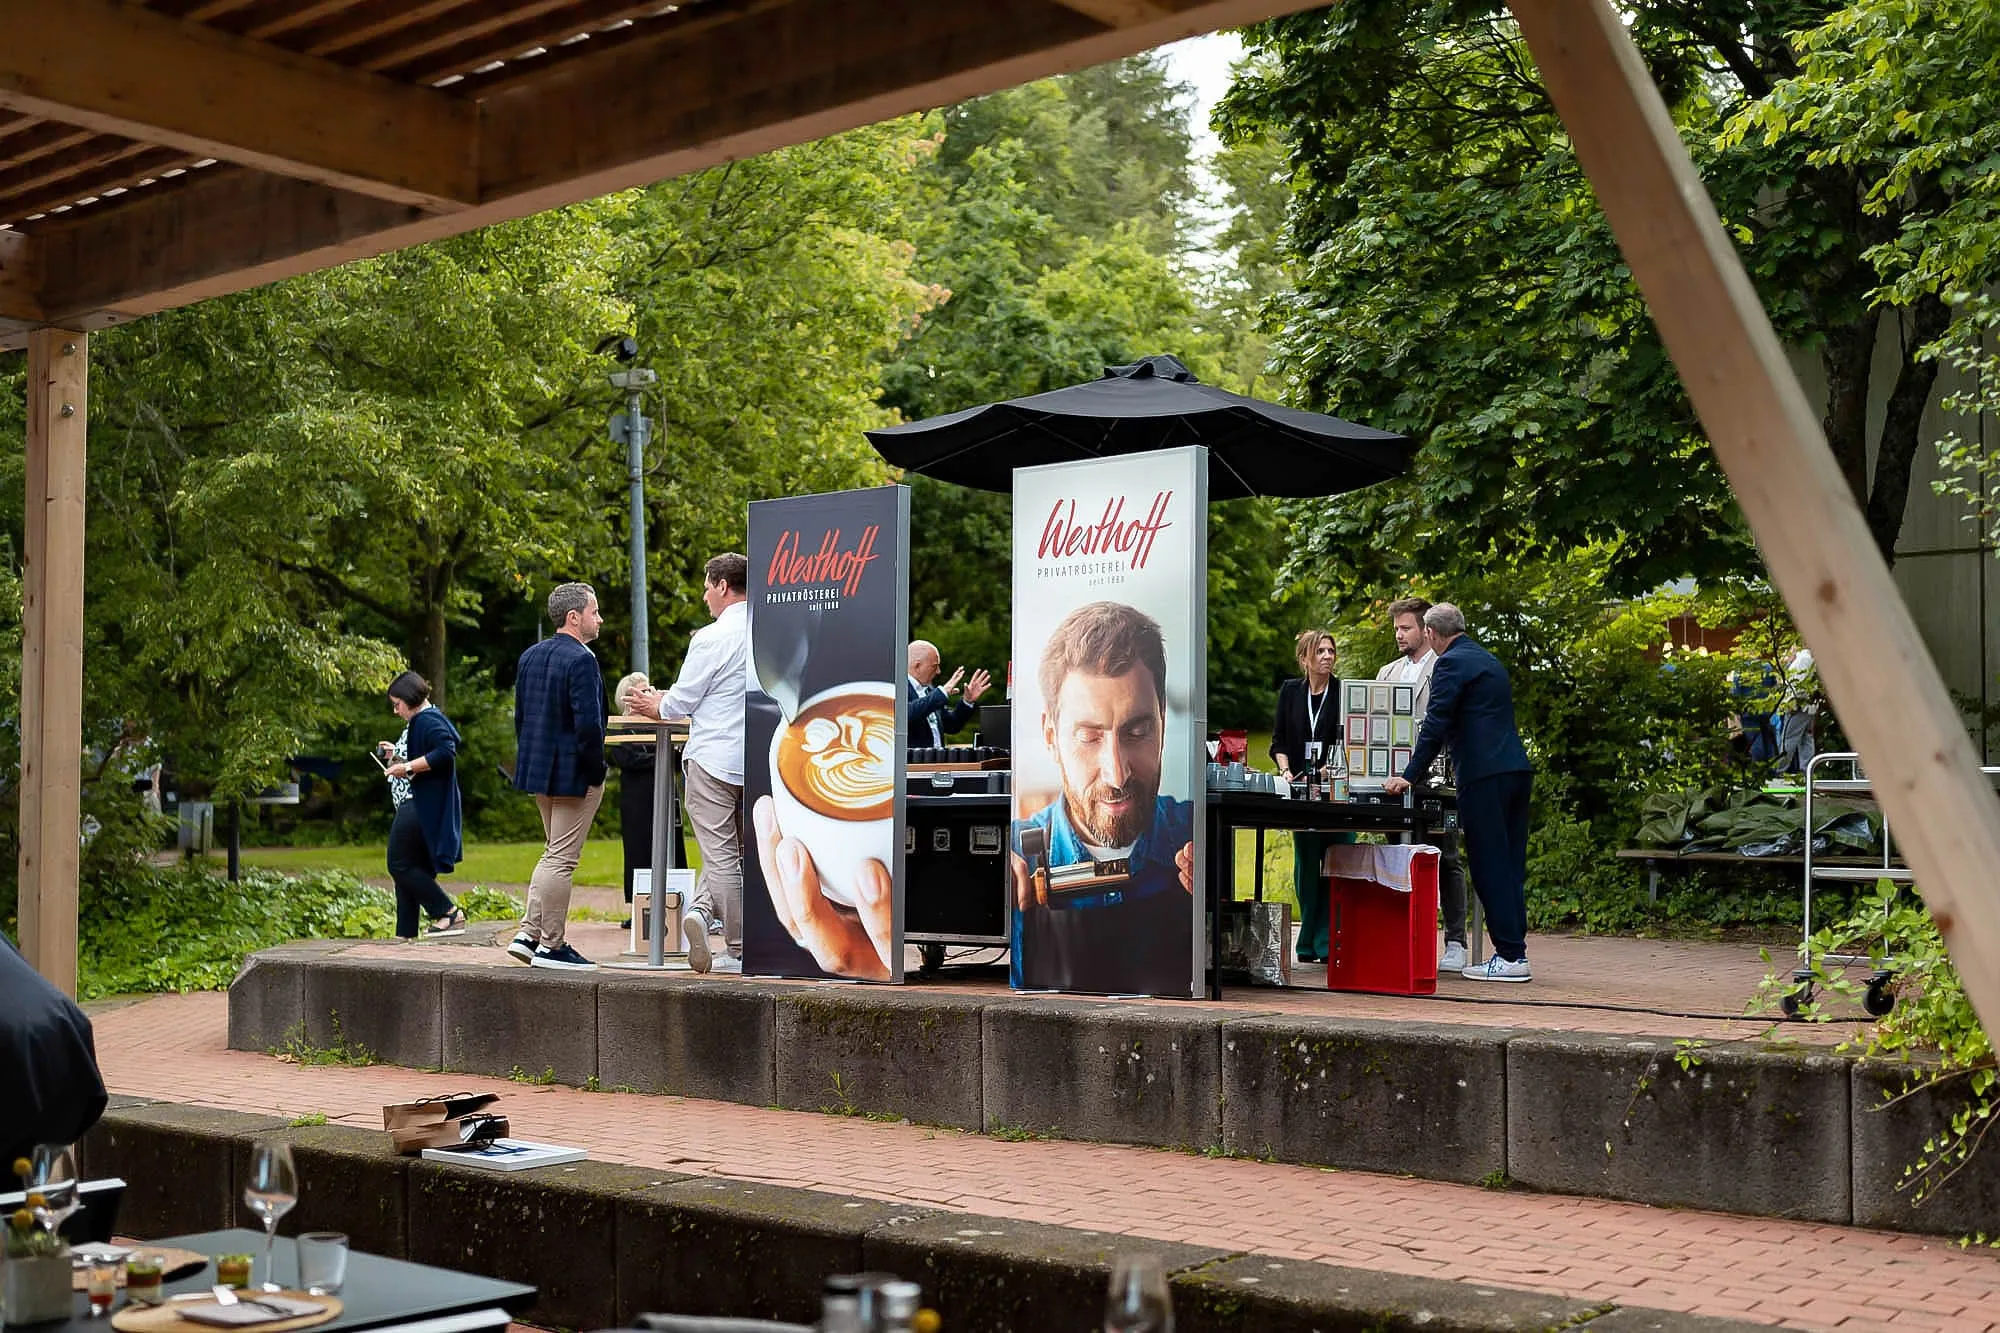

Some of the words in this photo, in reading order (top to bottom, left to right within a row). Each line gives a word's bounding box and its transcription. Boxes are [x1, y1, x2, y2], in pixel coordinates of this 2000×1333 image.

[1038, 490, 1173, 570] Westhoff
[767, 525, 880, 597] Westhoff
[1037, 561, 1125, 578] PRIVATRÖSTEREI
[766, 588, 839, 604] PRIVATRÖSTEREI
